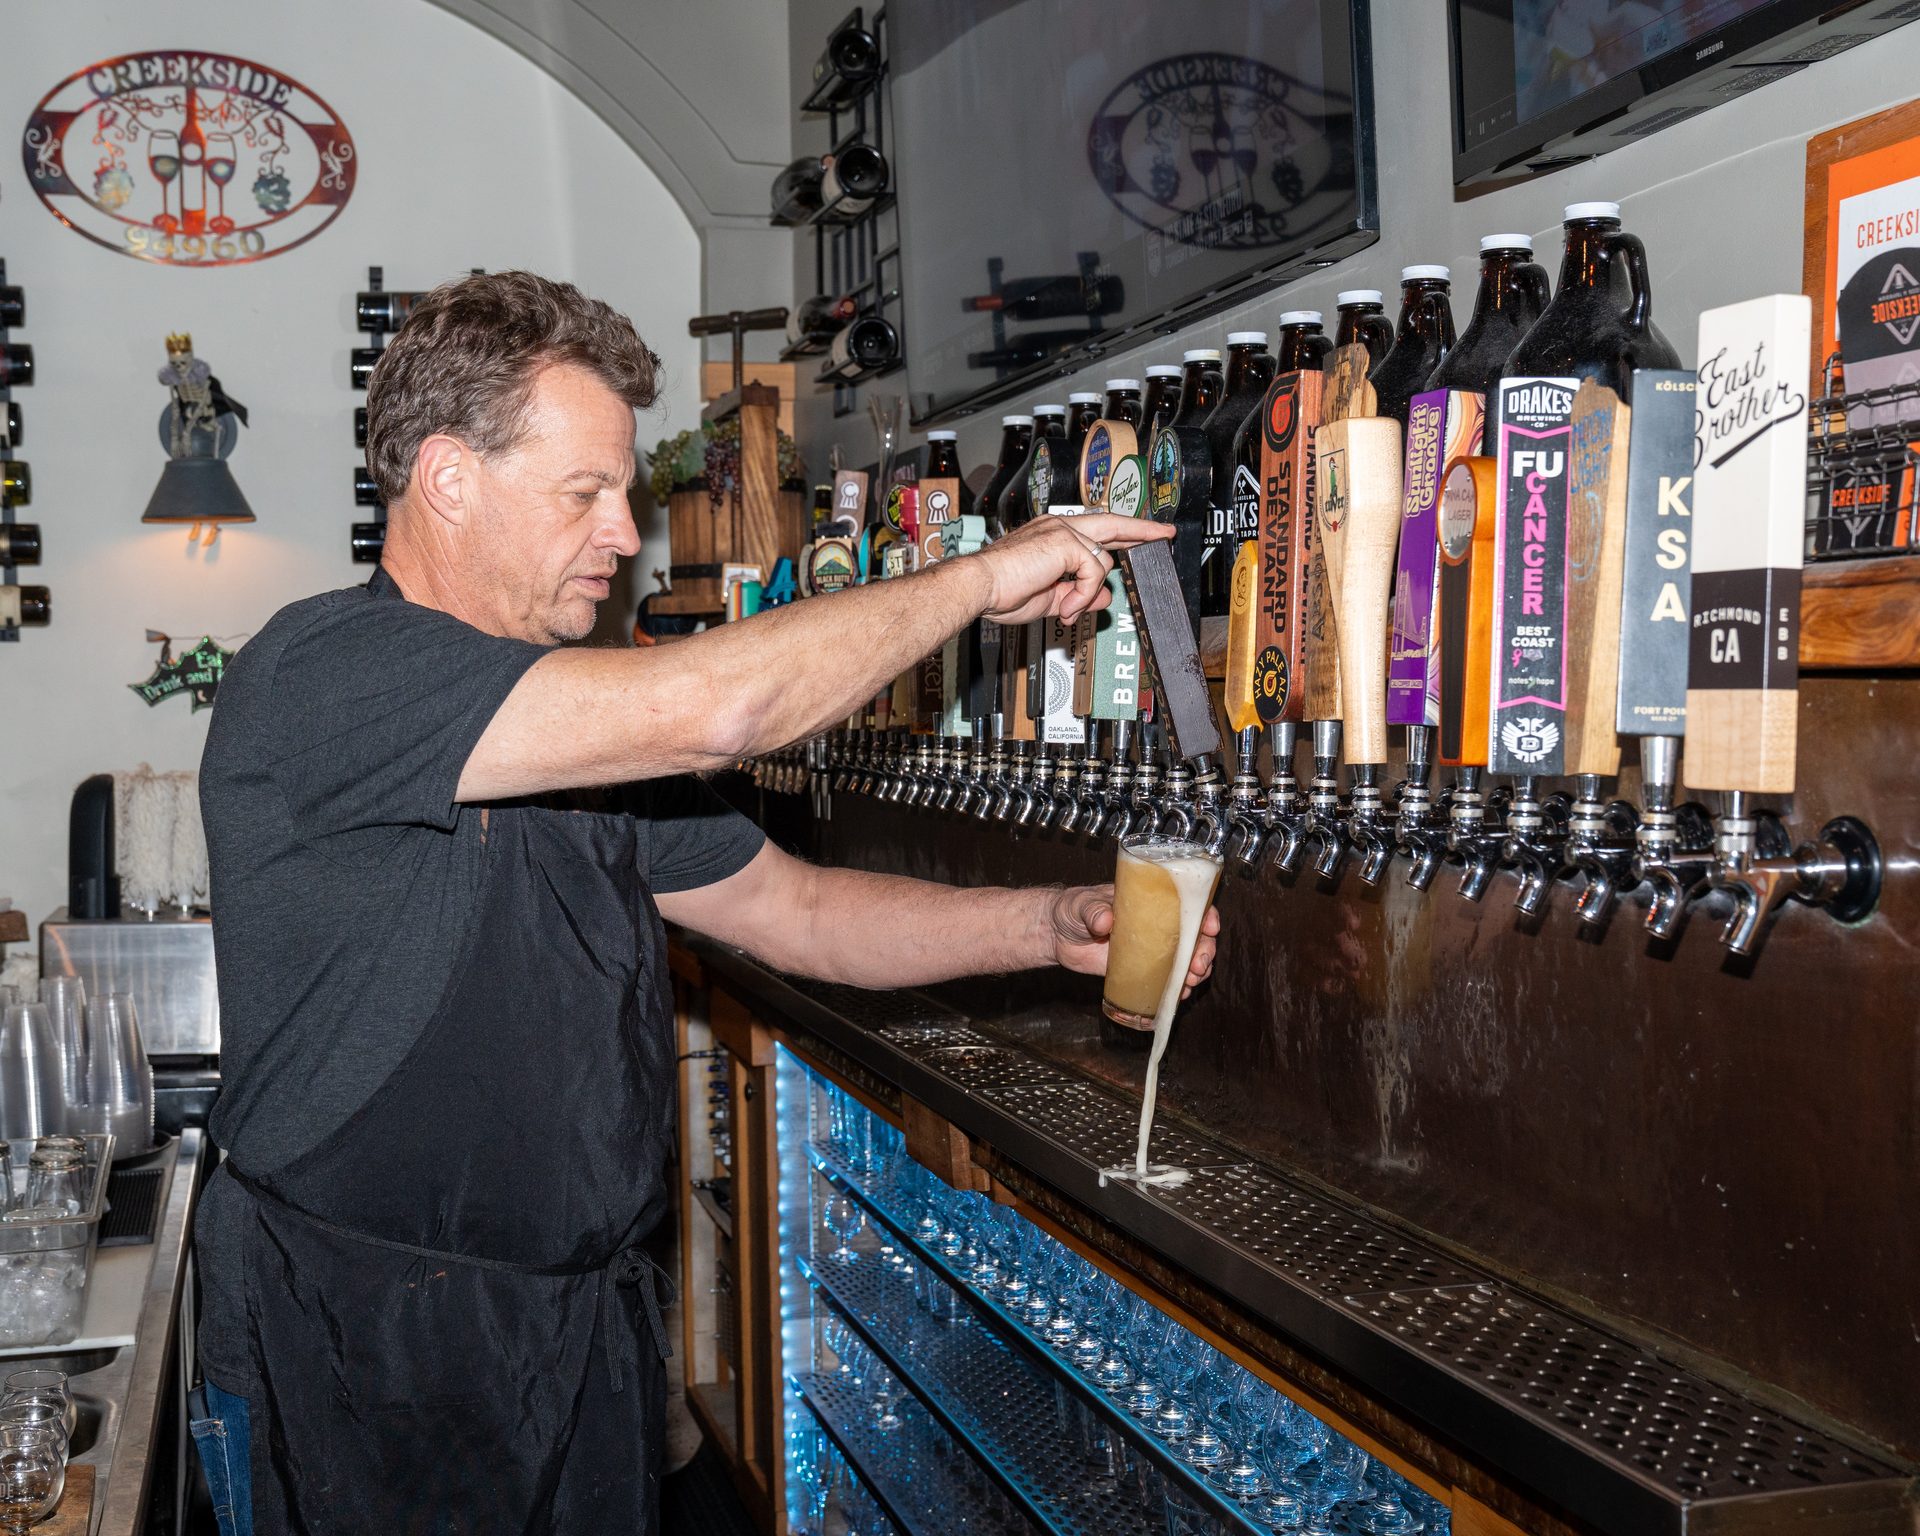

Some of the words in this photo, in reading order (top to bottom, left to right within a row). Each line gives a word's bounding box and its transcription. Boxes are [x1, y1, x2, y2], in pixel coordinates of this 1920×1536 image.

[1695, 40, 1725, 61] SAMSUNG
[87, 54, 294, 108] CREEKSIDE
[124, 226, 265, 260] 94960
[1655, 379, 1697, 392] KÖLSC
[1699, 341, 1766, 408] East
[1508, 385, 1573, 415] DRAKE'S
[1406, 403, 1429, 517] Sunlight
[1418, 407, 1442, 511] Groove
[1512, 450, 1564, 478] FU
[1111, 472, 1140, 511] Fairfax
[1125, 496, 1137, 504] BREW
[1263, 476, 1279, 620] DEVIANT
[1274, 460, 1291, 634] STANDARD
[1522, 471, 1548, 615] CANCER
[816, 575, 834, 584] BLACK
[834, 574, 850, 583] BUTTE
[1516, 625, 1552, 637] BEST
[1693, 606, 1762, 629] RICHMOND
[1511, 637, 1556, 648] COAST
[1709, 627, 1741, 664] CA
[143, 674, 184, 700] Drink
[186, 669, 213, 685] and
[1254, 655, 1265, 700] HAZY
[1265, 651, 1285, 672] PALE
[1276, 676, 1287, 707] ALE
[1633, 705, 1662, 715] FORT
[1047, 733, 1084, 741] CALIFORNIA
[1048, 725, 1080, 734] OAKLAND,
